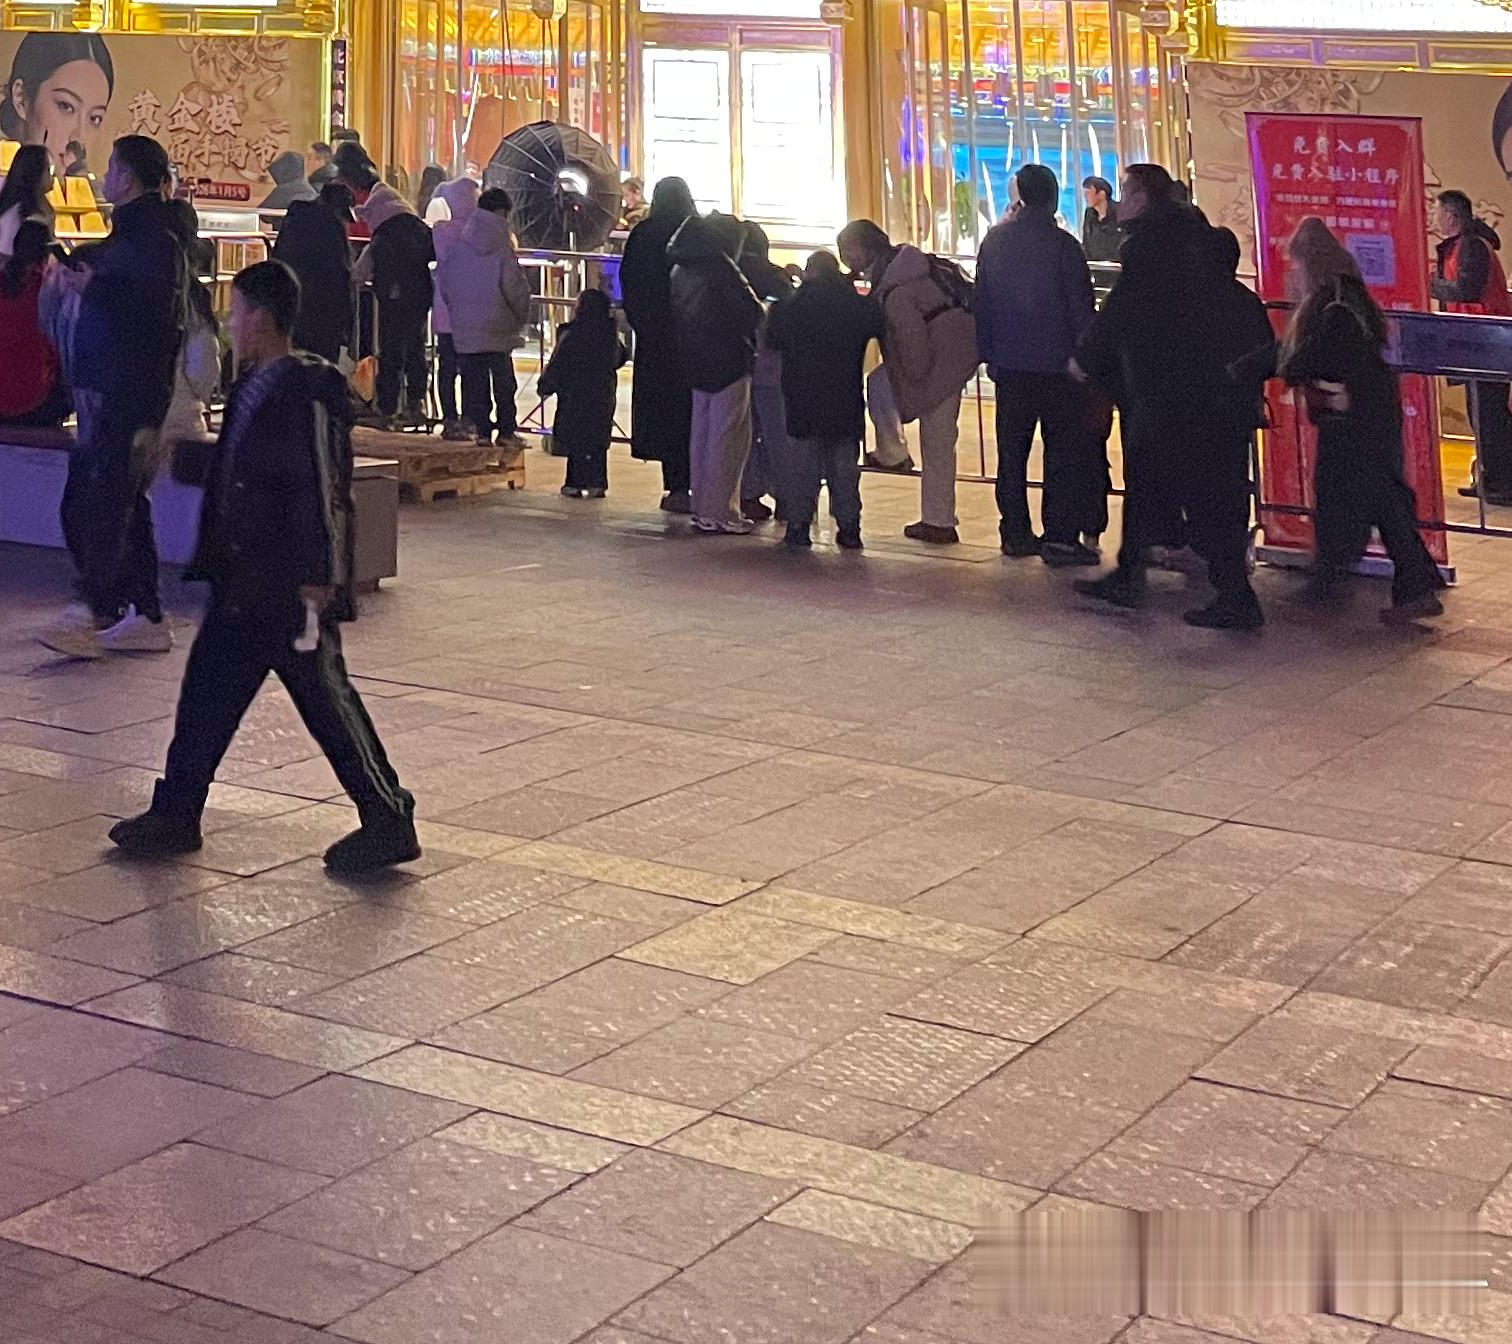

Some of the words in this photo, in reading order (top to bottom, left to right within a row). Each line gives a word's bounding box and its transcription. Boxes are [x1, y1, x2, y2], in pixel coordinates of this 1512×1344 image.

[128, 88, 243, 138] 黄金楼
[1293, 135, 1377, 157] 免费入群
